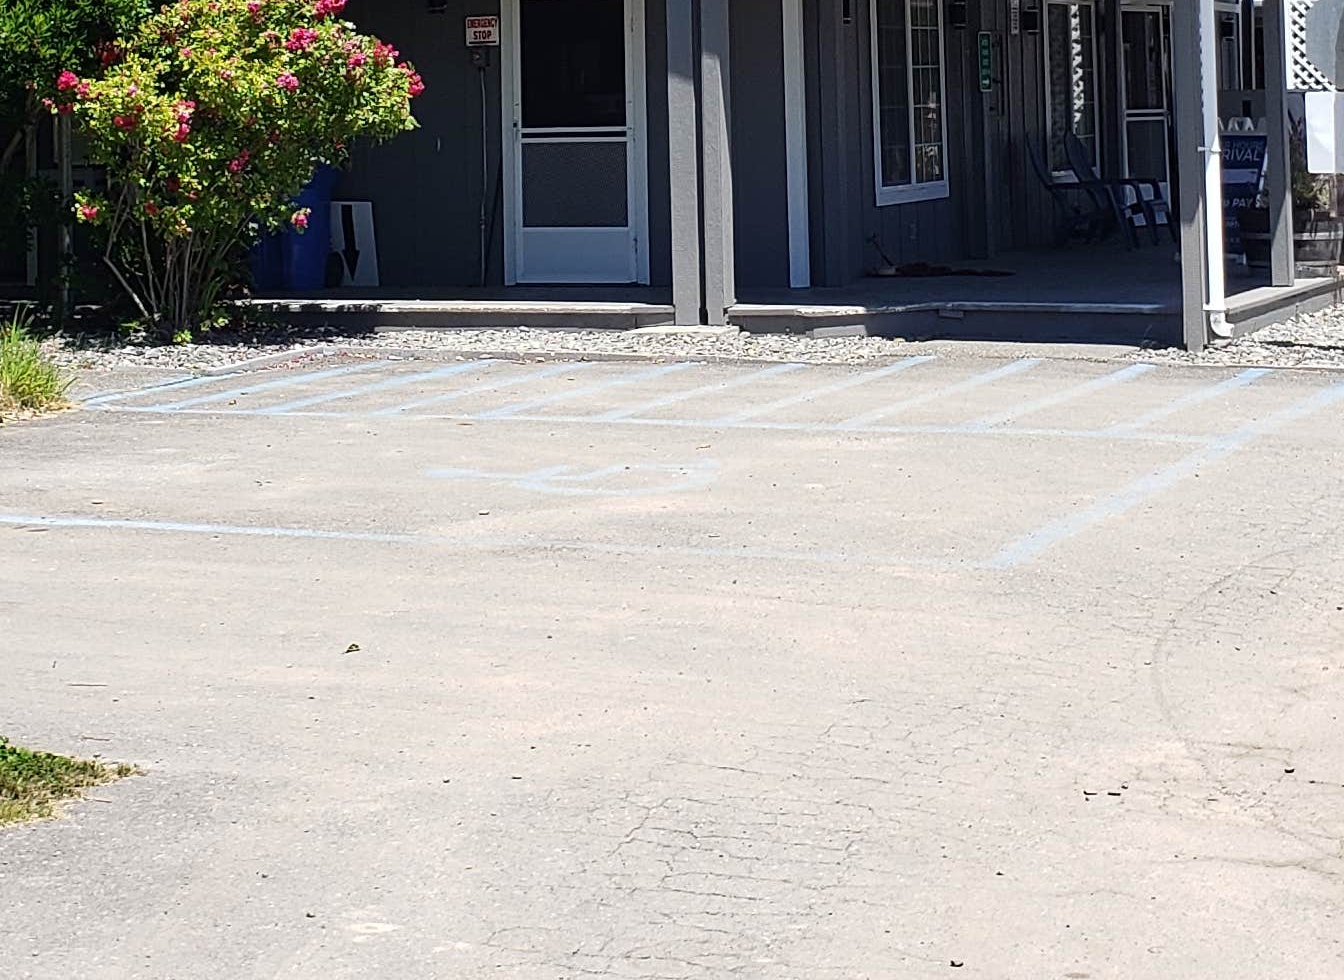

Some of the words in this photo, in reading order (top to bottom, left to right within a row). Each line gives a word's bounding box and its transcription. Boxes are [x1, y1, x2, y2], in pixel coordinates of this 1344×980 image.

[473, 30, 492, 40] STOP
[1223, 148, 1260, 162] RIVAL
[1232, 197, 1254, 208] PAY
